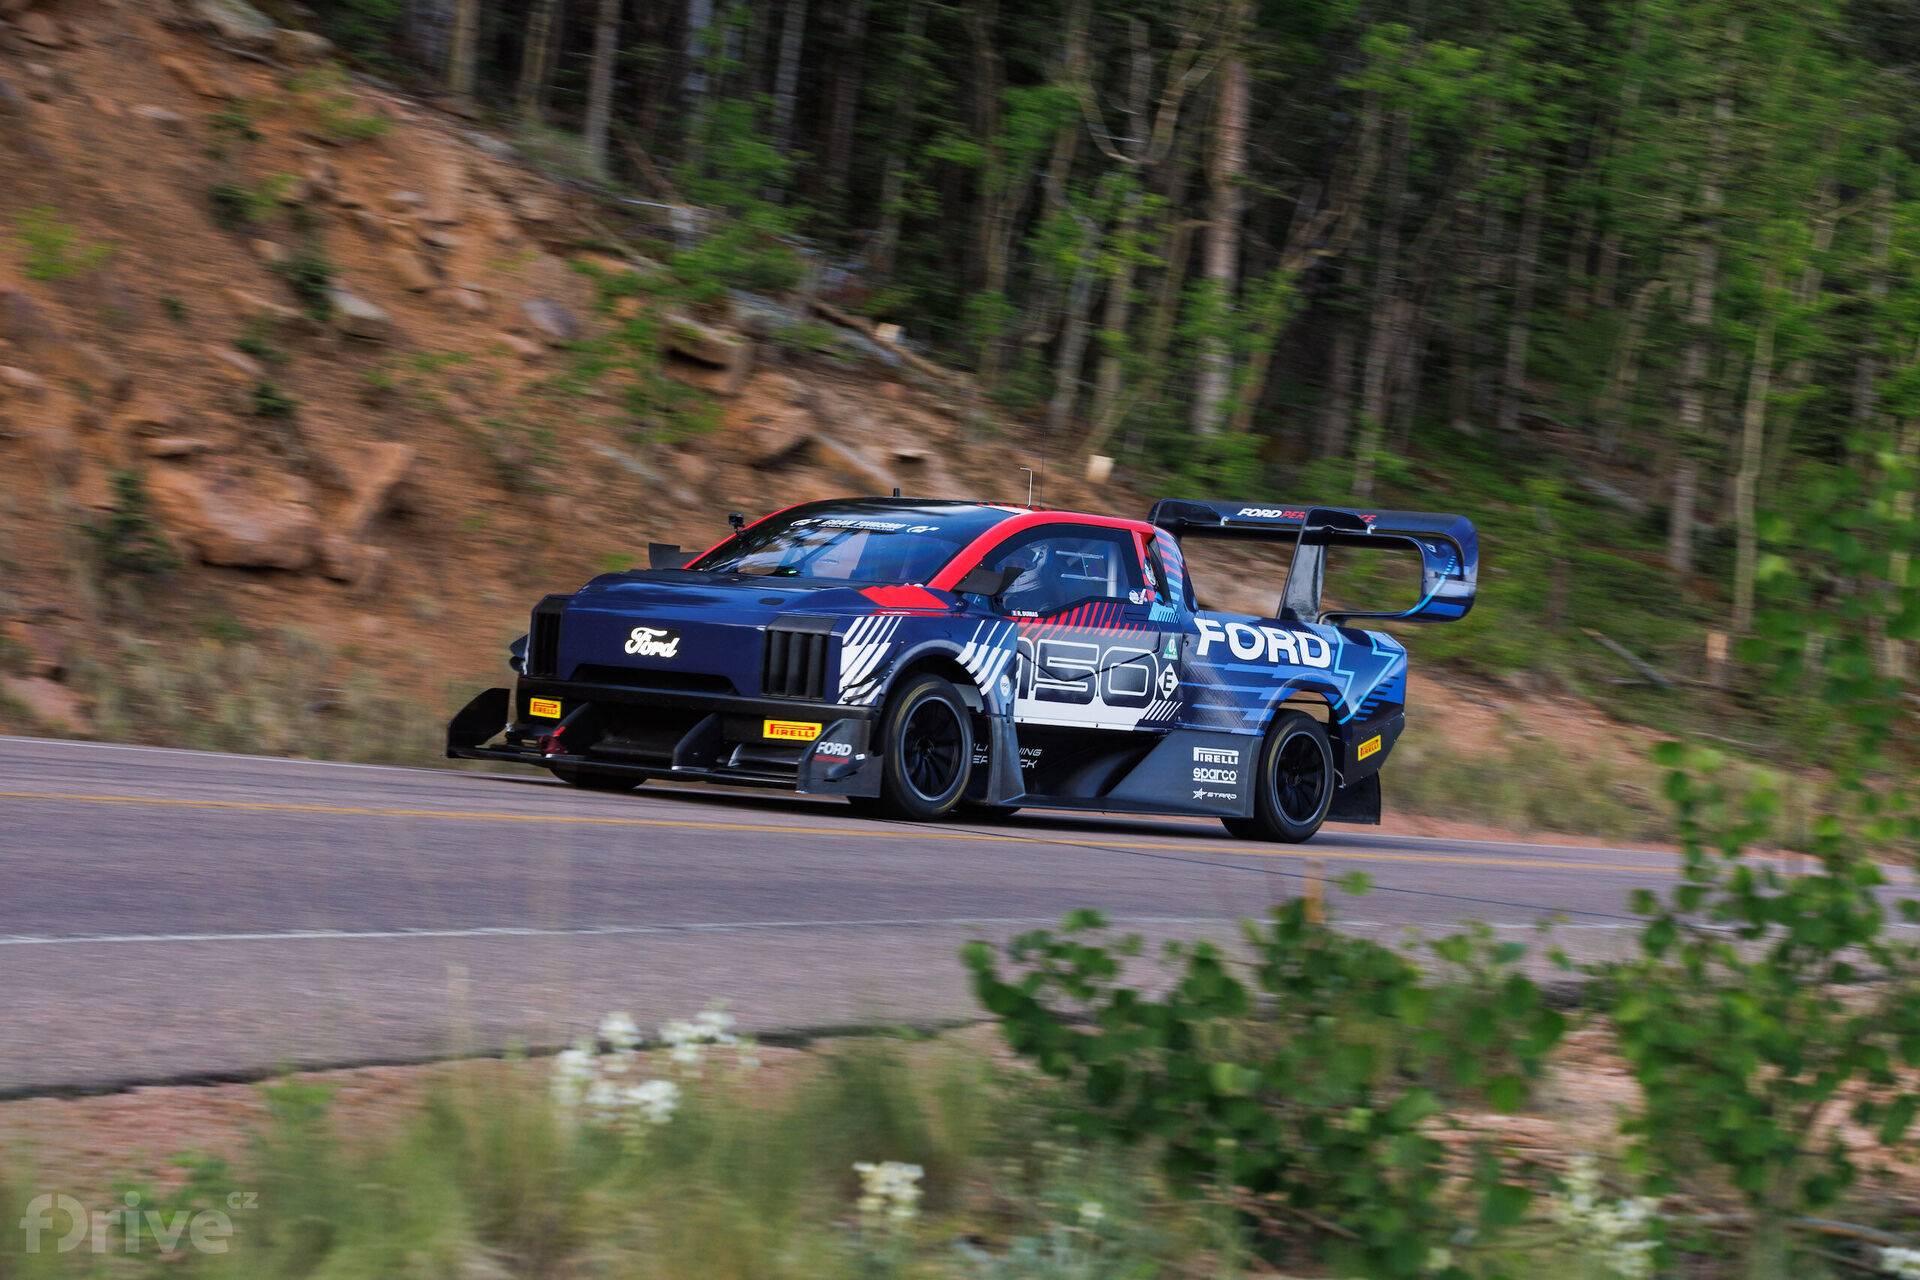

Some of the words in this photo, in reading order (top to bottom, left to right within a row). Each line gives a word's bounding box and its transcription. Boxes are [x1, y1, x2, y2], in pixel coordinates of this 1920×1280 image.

[1237, 507, 1282, 519] FORD
[625, 627, 680, 658] Ford
[1194, 617, 1332, 669] FORD
[1163, 671, 1173, 692] E
[533, 701, 558, 715] PIRELLI
[769, 723, 816, 738] PIRELLI
[815, 741, 852, 756] FORD
[1193, 746, 1240, 764] PIRELLI
[1360, 738, 1379, 757] PIRELLI
[1193, 767, 1237, 784] sparco
